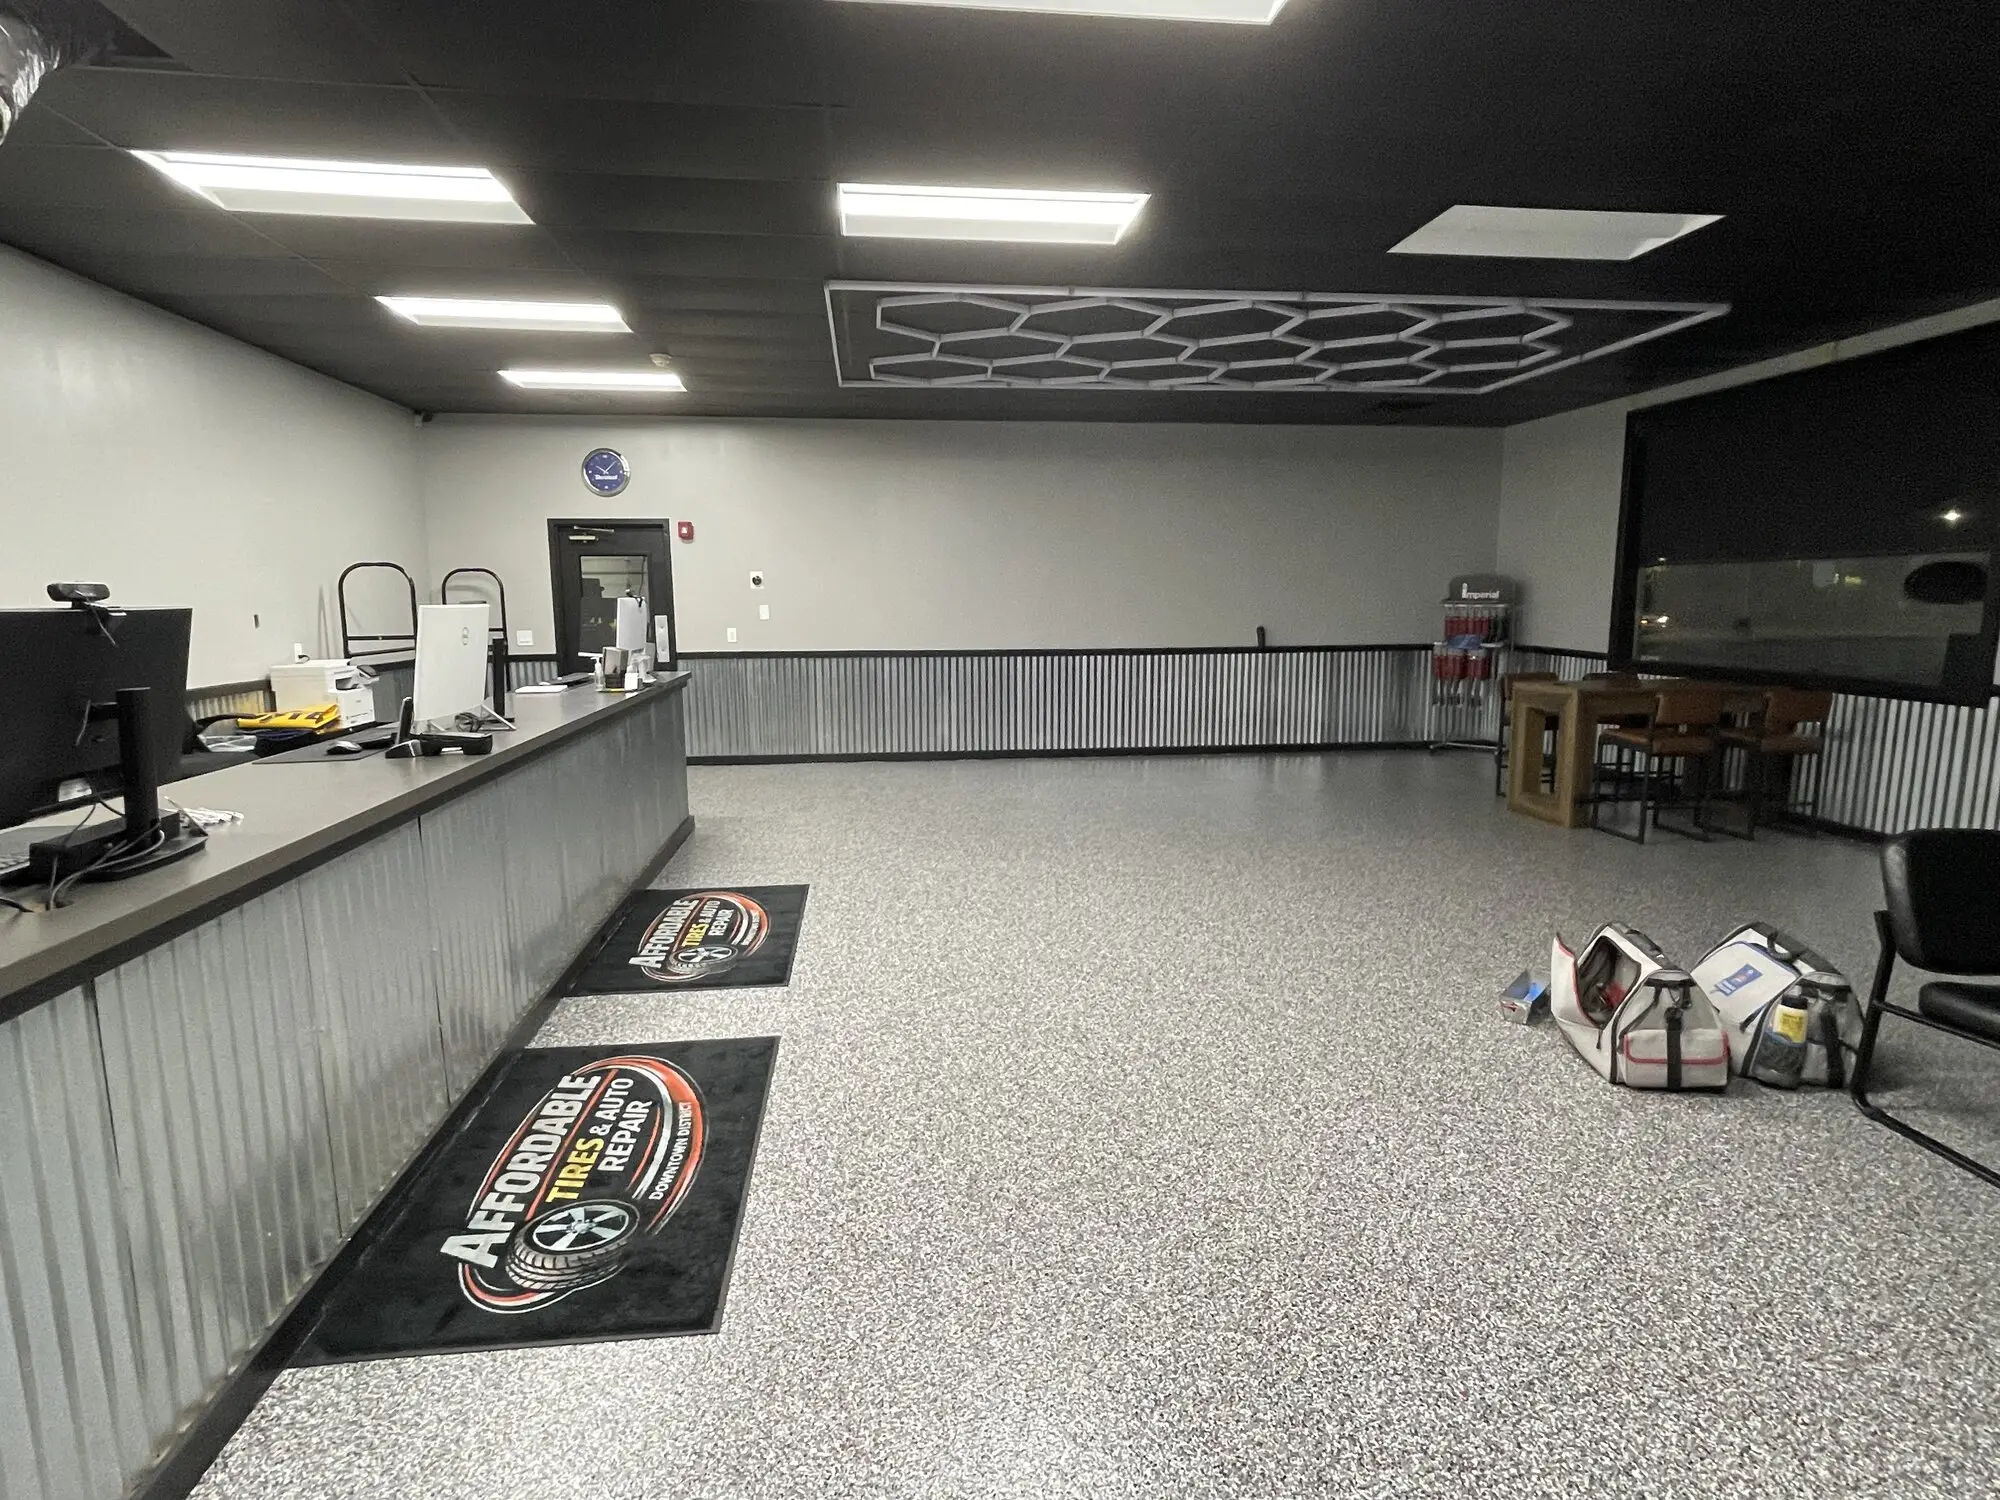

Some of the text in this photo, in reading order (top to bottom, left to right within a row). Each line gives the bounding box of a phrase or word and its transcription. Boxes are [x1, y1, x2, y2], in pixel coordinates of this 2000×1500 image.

[1461, 582, 1500, 600] Imperial
[628, 899, 700, 969] AFFORDABLE
[681, 923, 710, 947] TIRES
[700, 900, 721, 918] AUTO
[707, 909, 735, 936] REPAIR
[545, 1078, 634, 1203] TIRES & AUTO
[597, 1100, 652, 1171] REPAIR
[648, 1102, 692, 1200] DOWNTOWN DISTRICT
[440, 1074, 601, 1269] AFFORDABLE
